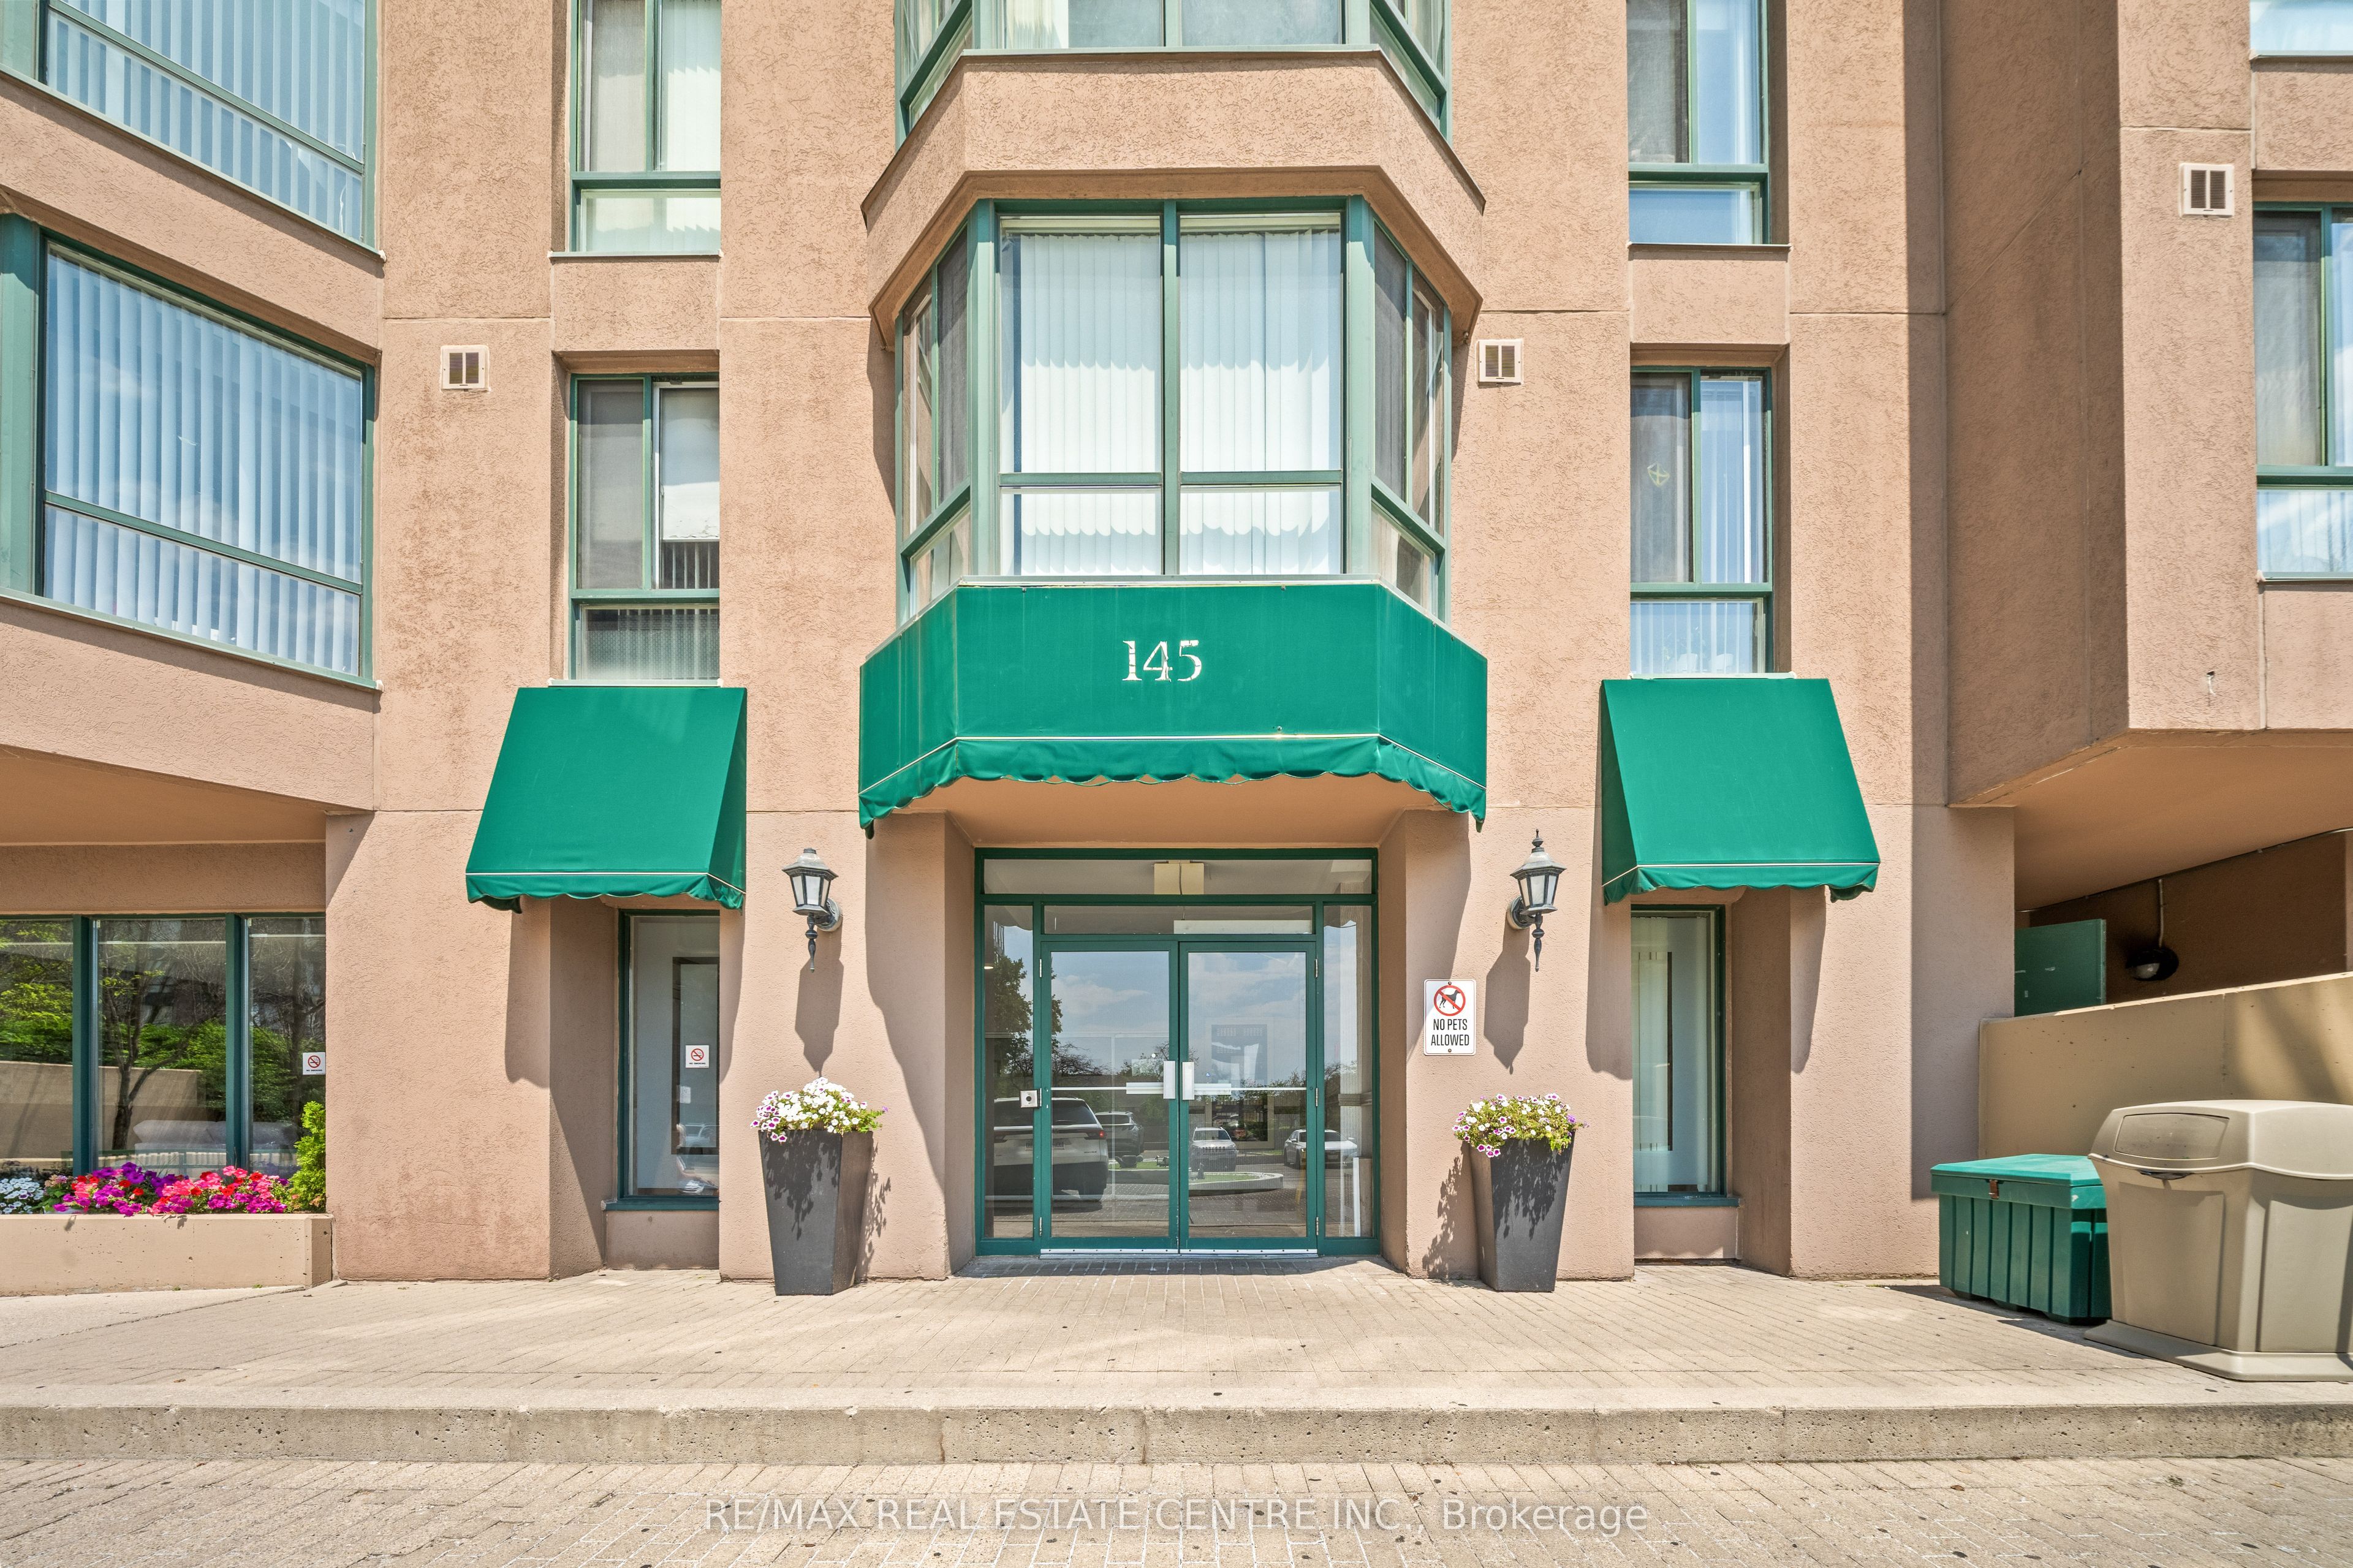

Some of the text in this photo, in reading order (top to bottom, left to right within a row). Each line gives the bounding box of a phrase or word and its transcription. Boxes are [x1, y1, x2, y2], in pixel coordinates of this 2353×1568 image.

[1122, 640, 1202, 682] 145
[1433, 1018, 1468, 1031] NO PETS
[1431, 1034, 1469, 1046] ALLOWED
